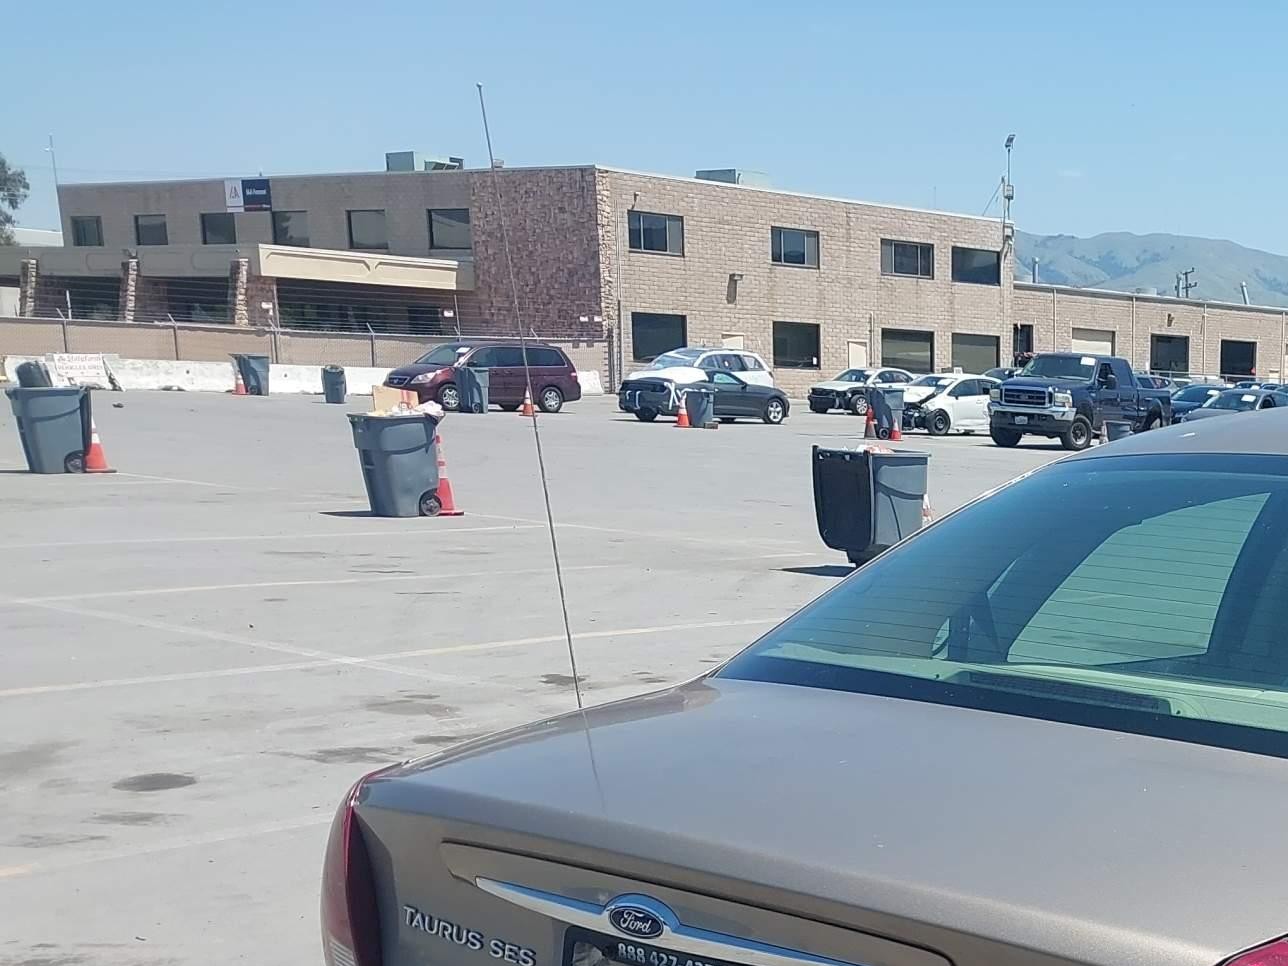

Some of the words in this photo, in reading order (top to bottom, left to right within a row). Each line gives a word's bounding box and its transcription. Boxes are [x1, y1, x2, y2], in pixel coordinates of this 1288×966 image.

[403, 905, 484, 950] TAURUS
[619, 909, 652, 934] Ford
[617, 943, 646, 963] 888
